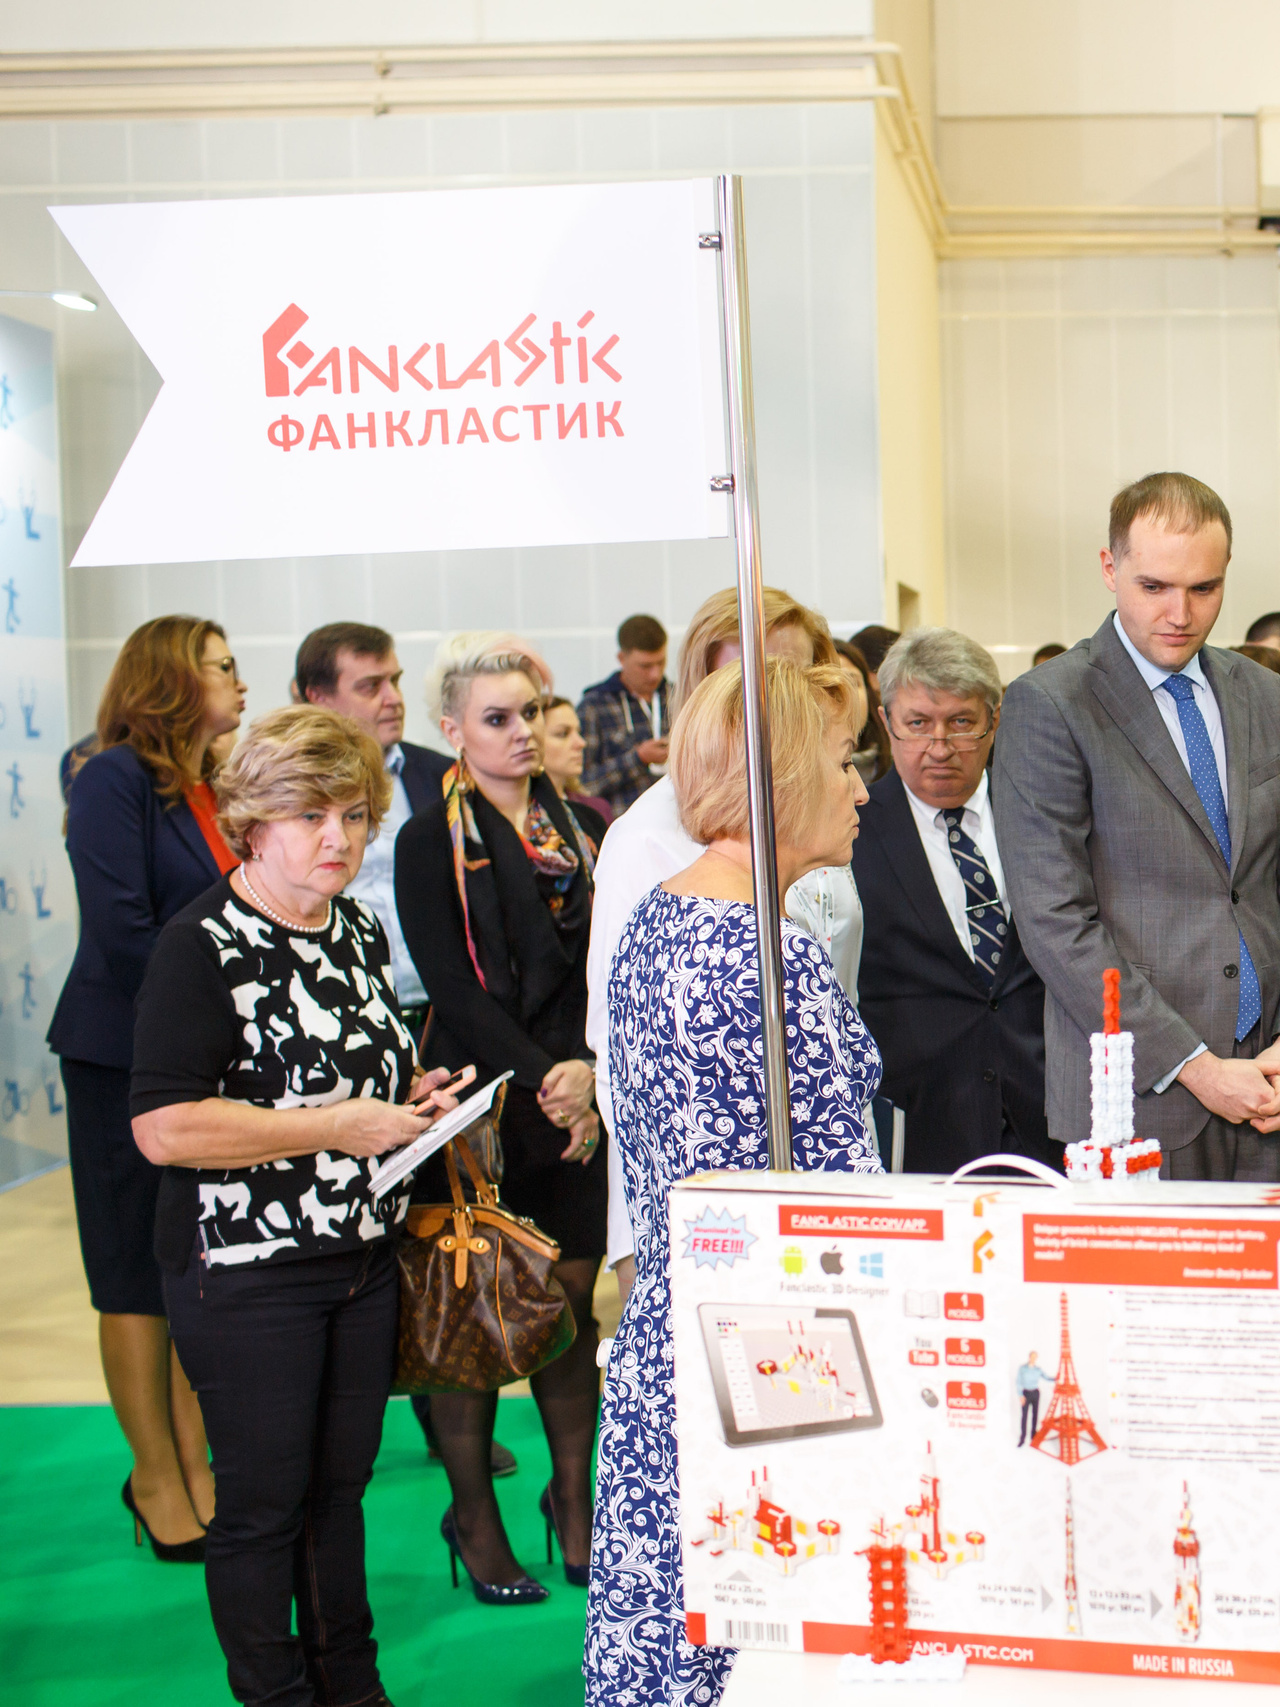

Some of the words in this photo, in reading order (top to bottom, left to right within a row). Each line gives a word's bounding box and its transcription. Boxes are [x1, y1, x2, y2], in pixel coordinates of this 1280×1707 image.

[266, 400, 625, 452] ФАНКЛАСТИК
[692, 1238, 744, 1253] FREE!!!
[960, 1292, 969, 1308] 1
[1133, 1653, 1169, 1673] MADE
[1171, 1656, 1186, 1674] IN
[1188, 1657, 1235, 1677] RUSSIA
